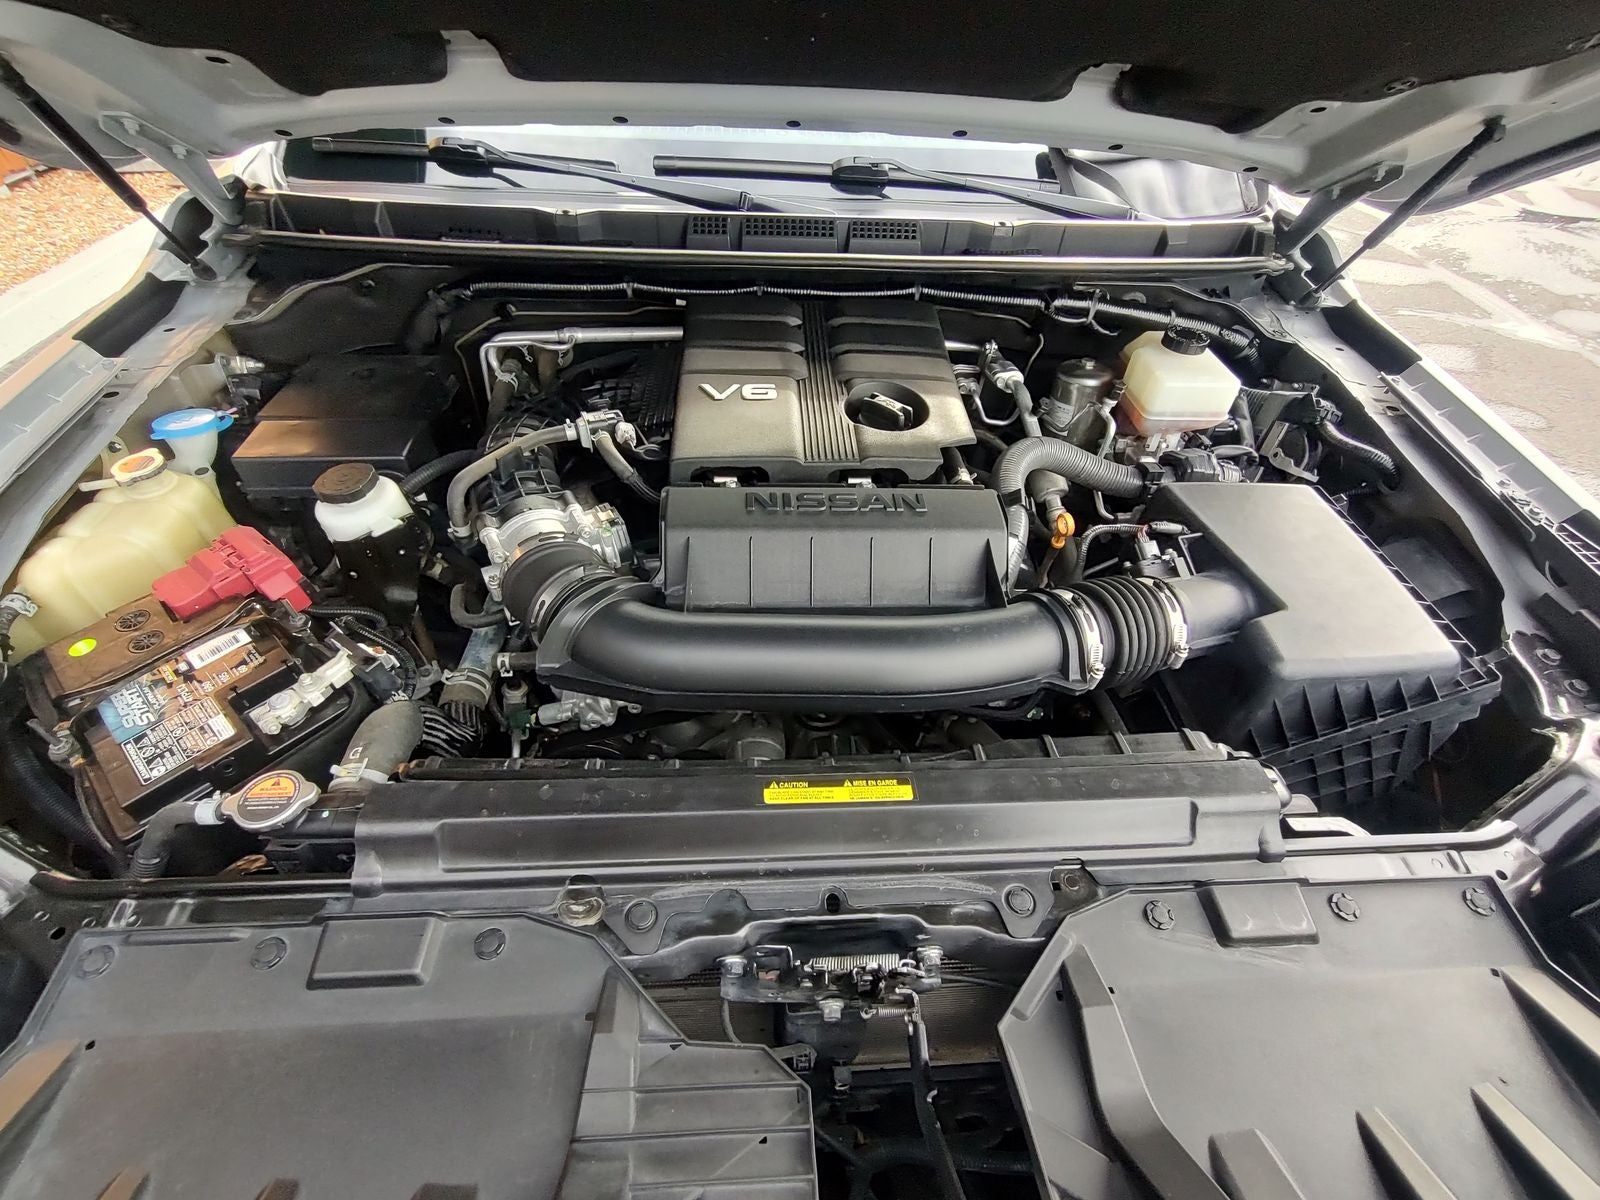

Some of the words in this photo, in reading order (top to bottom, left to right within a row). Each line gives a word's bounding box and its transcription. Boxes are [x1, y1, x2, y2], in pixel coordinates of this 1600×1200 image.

[698, 383, 778, 401] V6
[745, 492, 928, 512] NISSAN
[110, 690, 135, 729] SUPER
[126, 687, 156, 726] START
